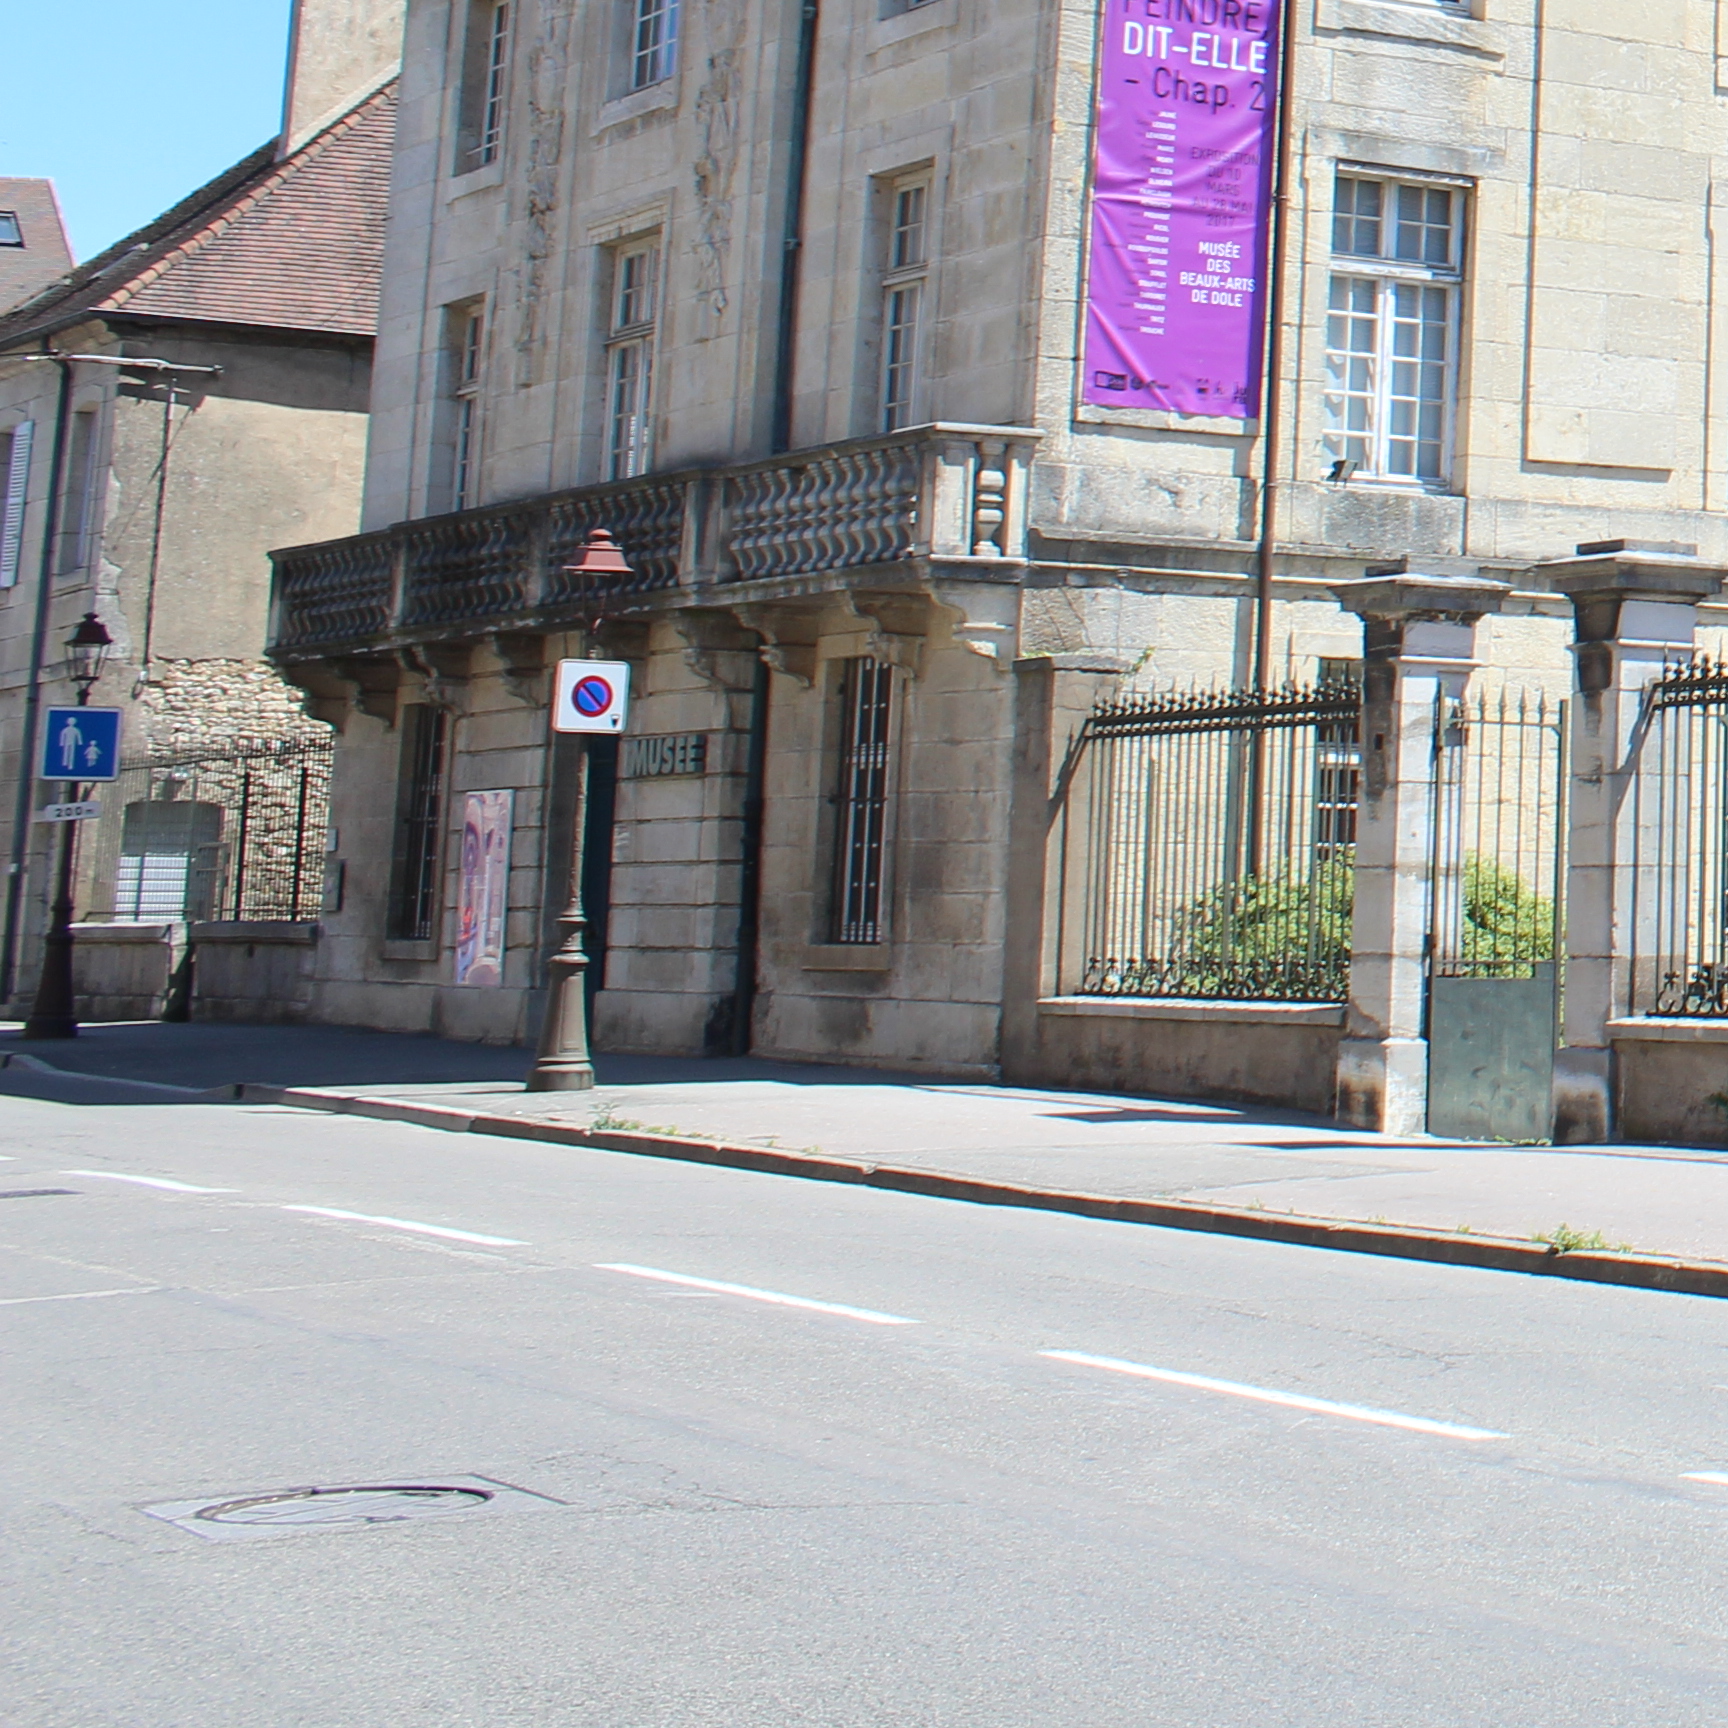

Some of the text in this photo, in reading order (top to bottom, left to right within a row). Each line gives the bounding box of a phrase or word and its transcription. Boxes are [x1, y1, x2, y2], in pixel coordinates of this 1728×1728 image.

[1122, 20, 1269, 74] DIT-ELLE
[1153, 66, 1236, 115] Chap.
[1249, 79, 1266, 112] 2
[1190, 146, 1260, 166] EXPOSITION
[1207, 165, 1223, 178] DU
[1206, 181, 1241, 196] MARS
[1198, 240, 1241, 259] MUSÉE
[1206, 258, 1231, 274] DES
[1179, 271, 1256, 293] BEAUX-ARTS
[1191, 288, 1243, 307] DE DOLE
[54, 806, 83, 818] 200
